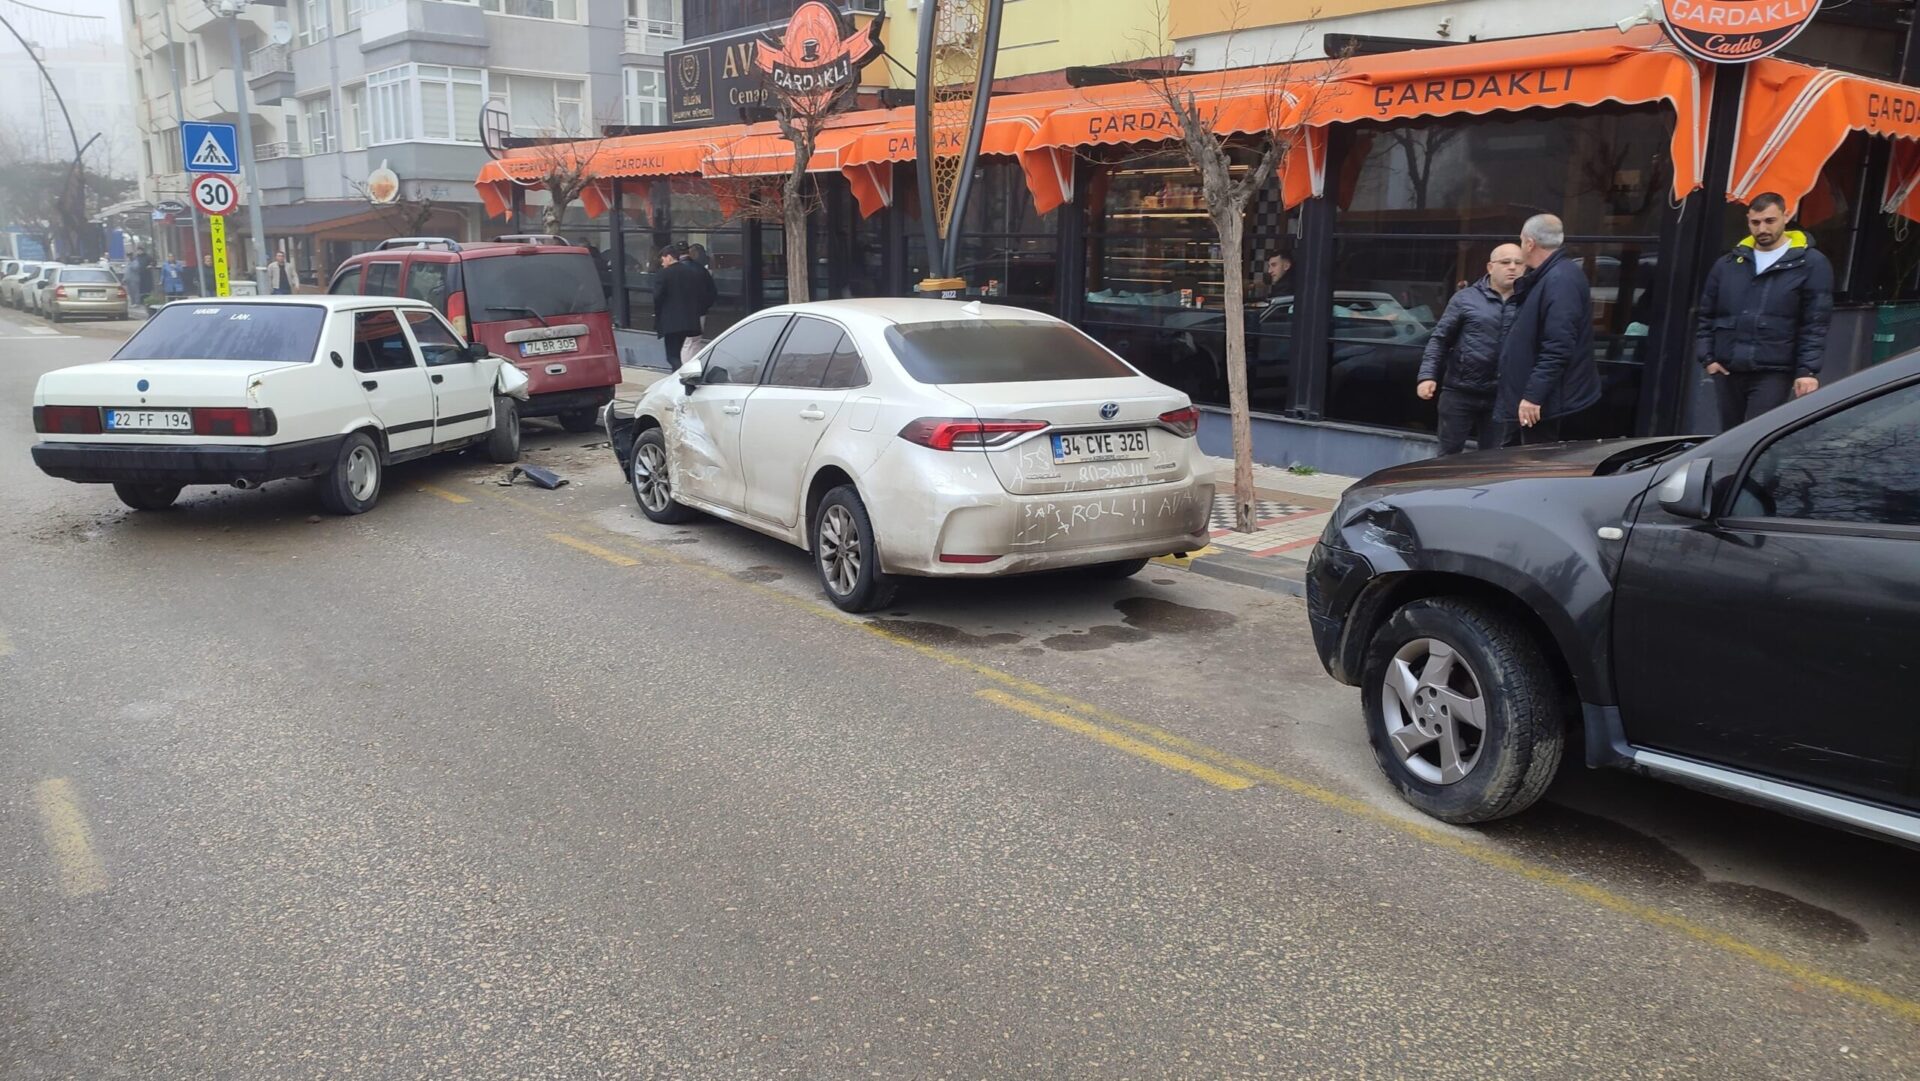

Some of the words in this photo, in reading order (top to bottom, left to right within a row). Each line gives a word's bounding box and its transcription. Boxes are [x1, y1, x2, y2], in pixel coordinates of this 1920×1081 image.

[1705, 34, 1763, 54] Cadde
[729, 87, 768, 106] Cenap
[1374, 68, 1573, 114] ÇARDAKLI
[1868, 93, 1920, 127] ÇARD
[200, 183, 229, 206] 30
[215, 228, 224, 264] YAYA
[527, 342, 541, 353] 74
[543, 341, 555, 351] BR
[558, 338, 576, 349] 305
[115, 413, 131, 426] 22
[139, 413, 155, 426] FF
[164, 413, 189, 427] 194
[1062, 437, 1080, 455] 34
[1086, 434, 1113, 453] CVE
[1119, 432, 1144, 451] 326
[1072, 499, 1125, 527] ROLL
